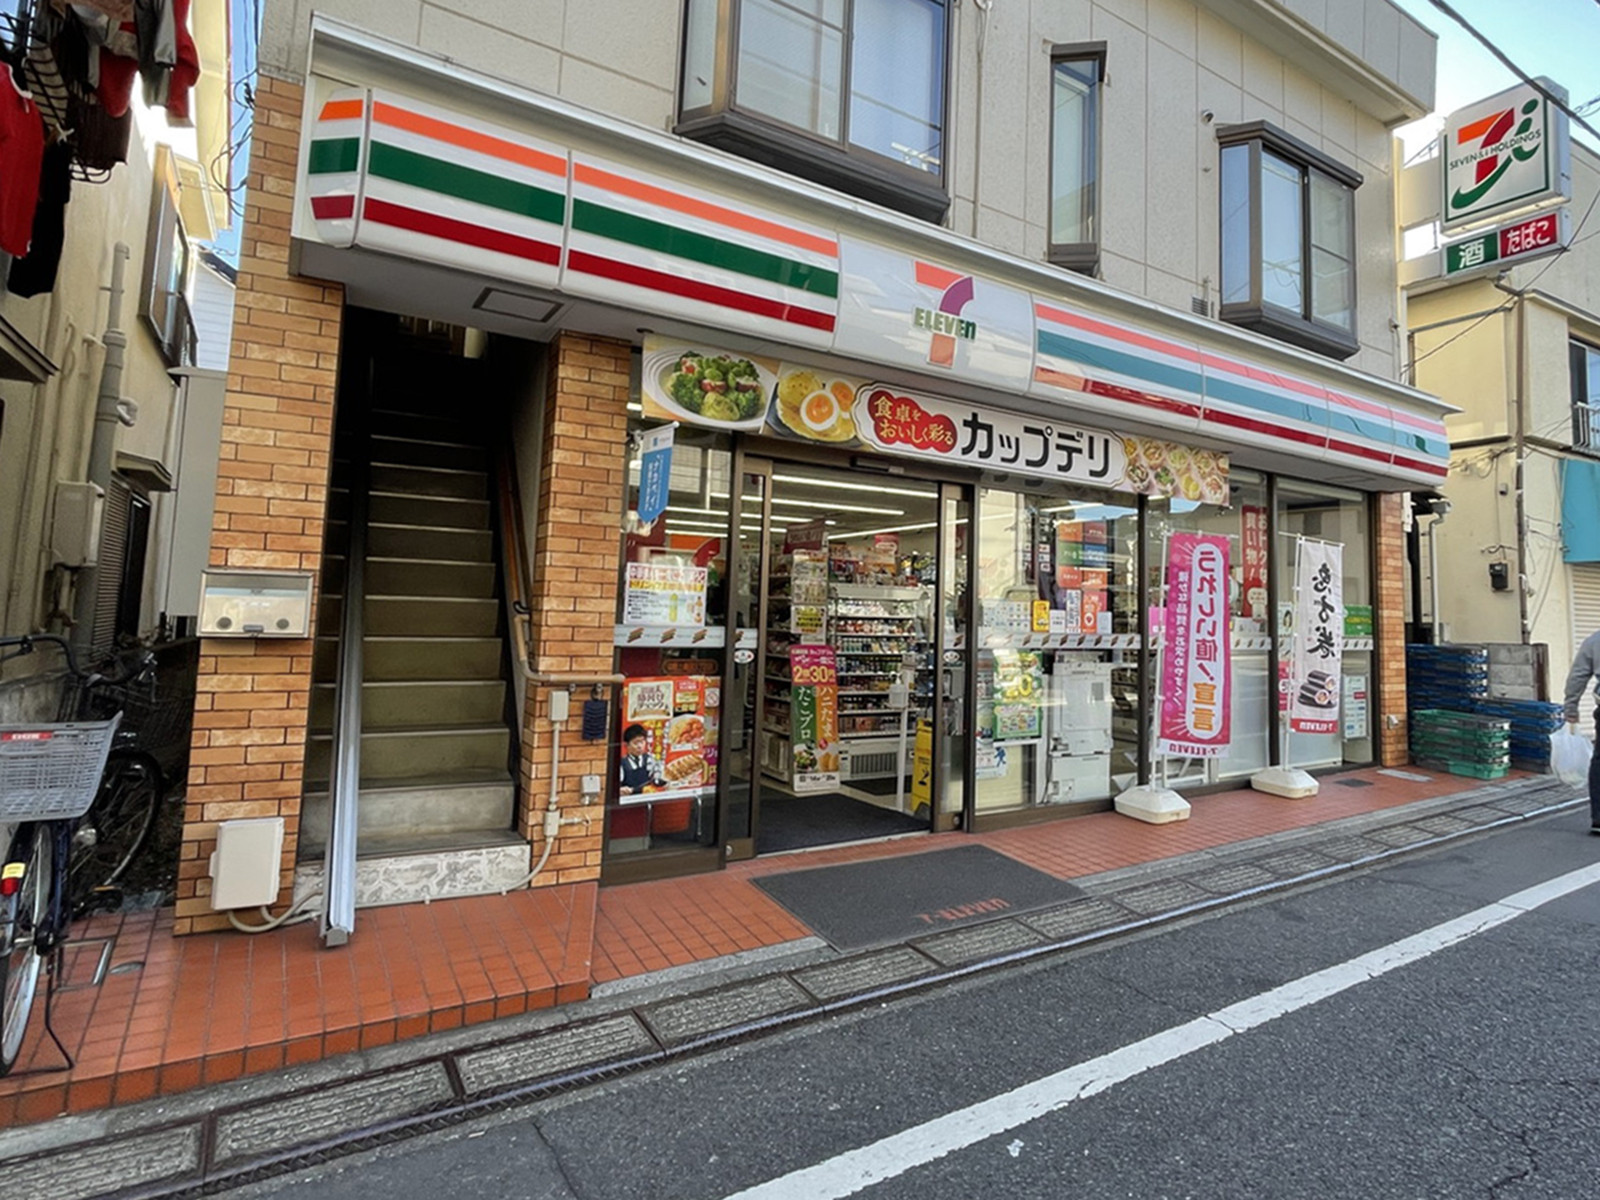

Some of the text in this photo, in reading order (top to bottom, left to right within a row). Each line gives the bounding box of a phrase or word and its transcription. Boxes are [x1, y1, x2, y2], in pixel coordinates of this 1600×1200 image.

[1449, 152, 1478, 170] SEVEN
[1490, 128, 1542, 155] HOLDINGS
[1459, 238, 1485, 269] 酒
[1506, 220, 1551, 255] たばこ
[873, 395, 922, 424] 食卓を
[879, 418, 954, 446] おいしく彩る
[961, 412, 1110, 478] カップデリ
